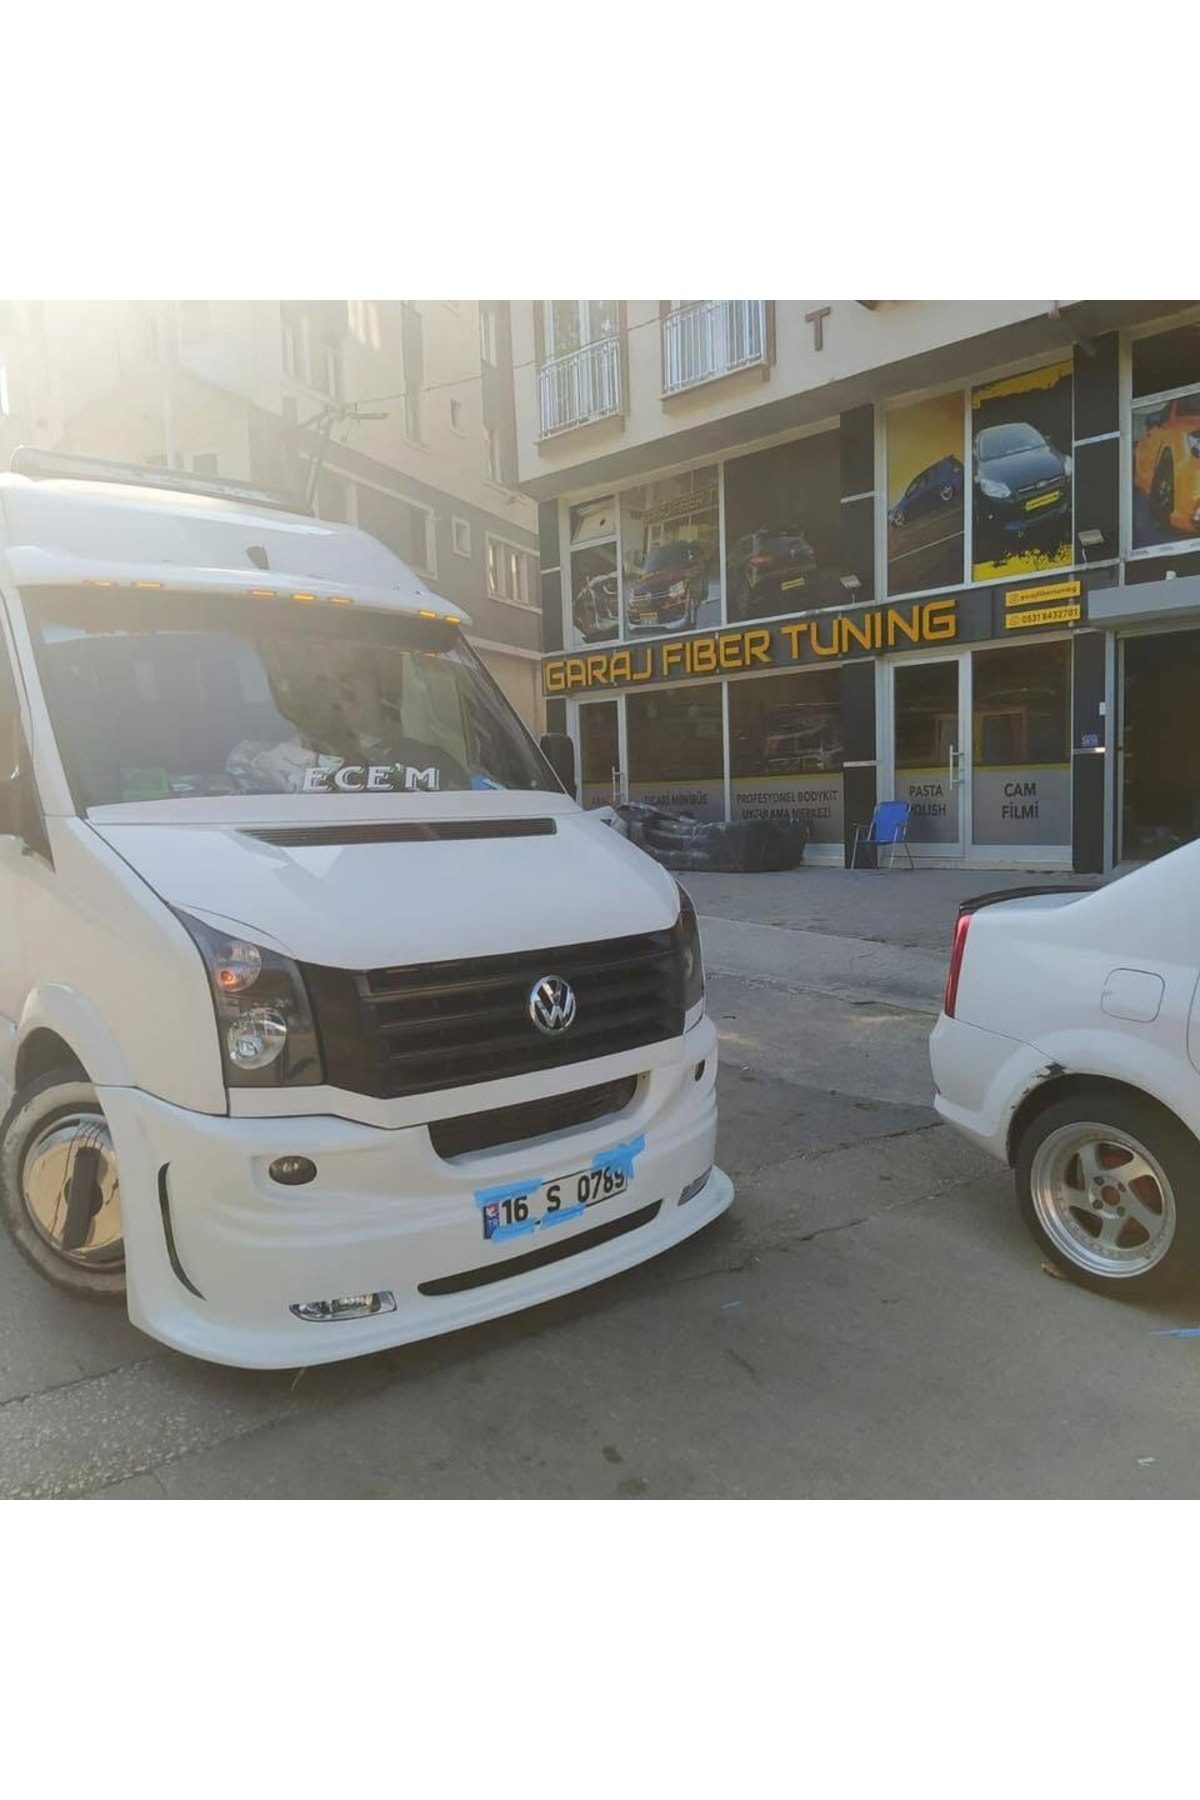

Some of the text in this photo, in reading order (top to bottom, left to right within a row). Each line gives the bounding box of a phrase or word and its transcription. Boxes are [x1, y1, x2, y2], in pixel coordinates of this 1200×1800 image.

[545, 599, 956, 691] GARAJ FIBER TUNING
[909, 783, 944, 797] PASTA
[1004, 782, 1037, 797] CAM
[909, 803, 946, 817] OLISH
[501, 1195, 529, 1225] 16
[546, 1184, 561, 1213] S
